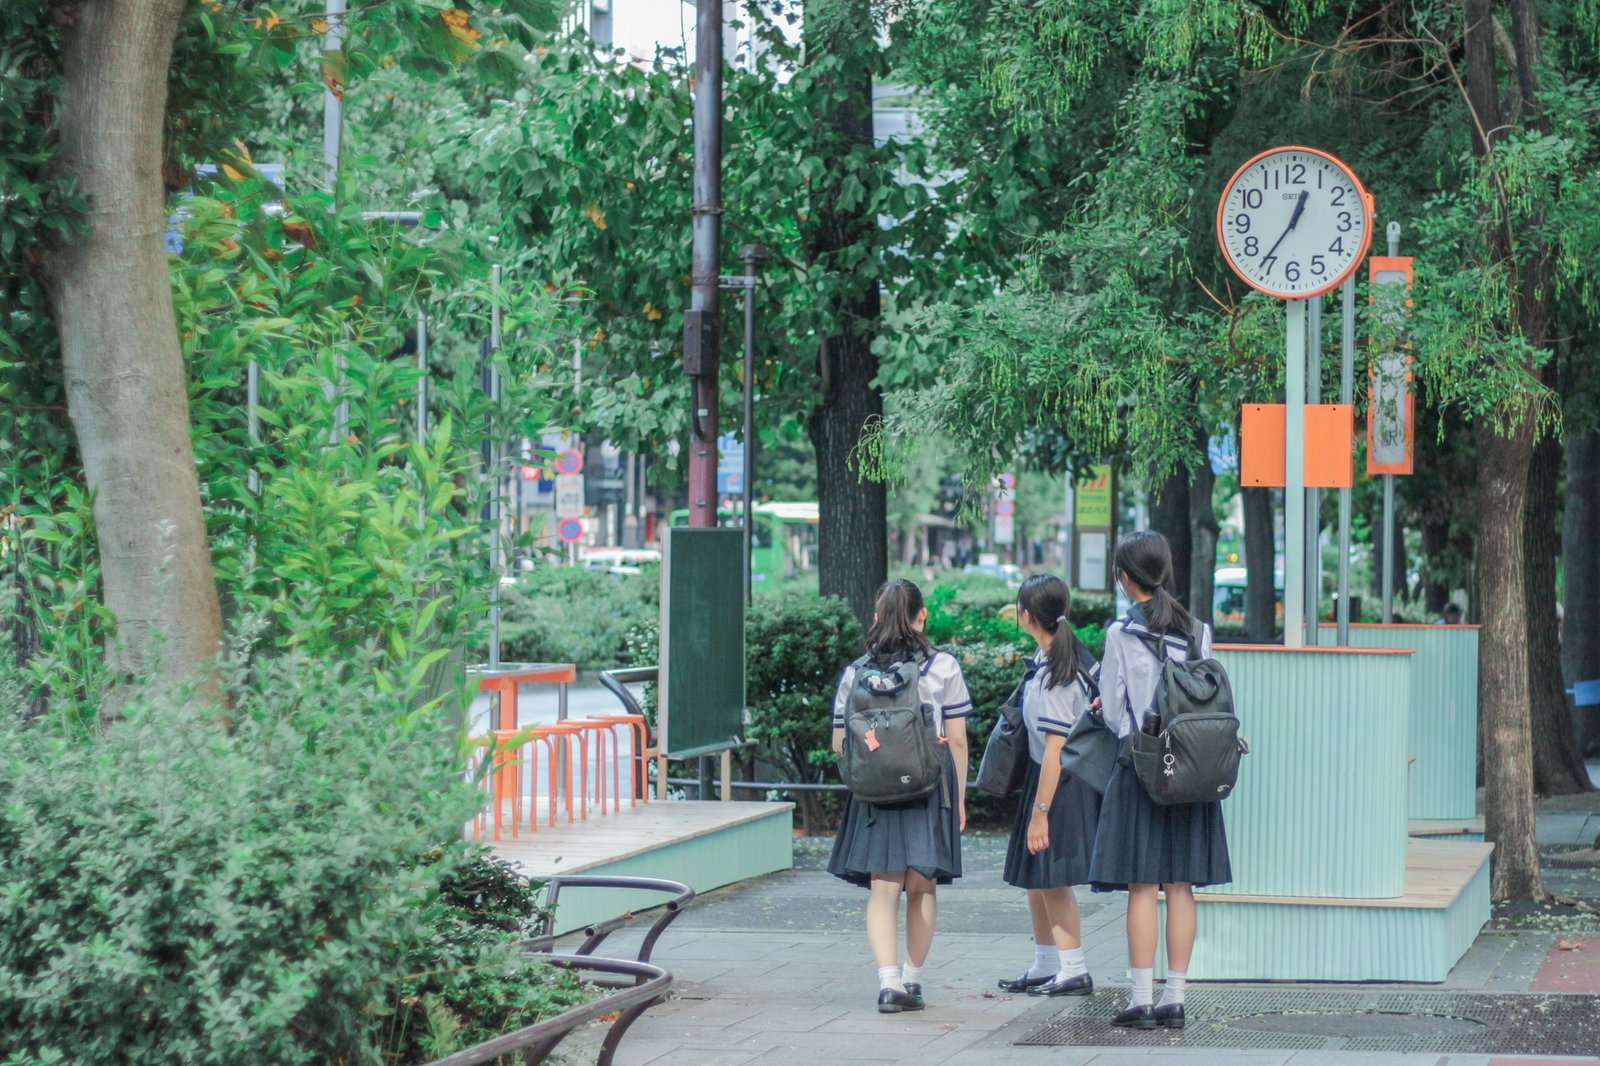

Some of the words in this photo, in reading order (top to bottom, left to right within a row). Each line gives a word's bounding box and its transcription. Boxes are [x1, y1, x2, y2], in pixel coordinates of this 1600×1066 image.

[1264, 170, 1279, 190] 11
[1285, 164, 1306, 184] 12
[1318, 169, 1322, 189] 1
[1242, 188, 1263, 209] 10
[1330, 186, 1345, 206] 2
[1235, 213, 1250, 234] 9
[1336, 211, 1352, 232] 3
[1243, 236, 1259, 257] 8
[1328, 236, 1344, 256] 4
[1263, 256, 1278, 276] 7
[1285, 261, 1300, 282] 6
[1310, 255, 1326, 275] 5
